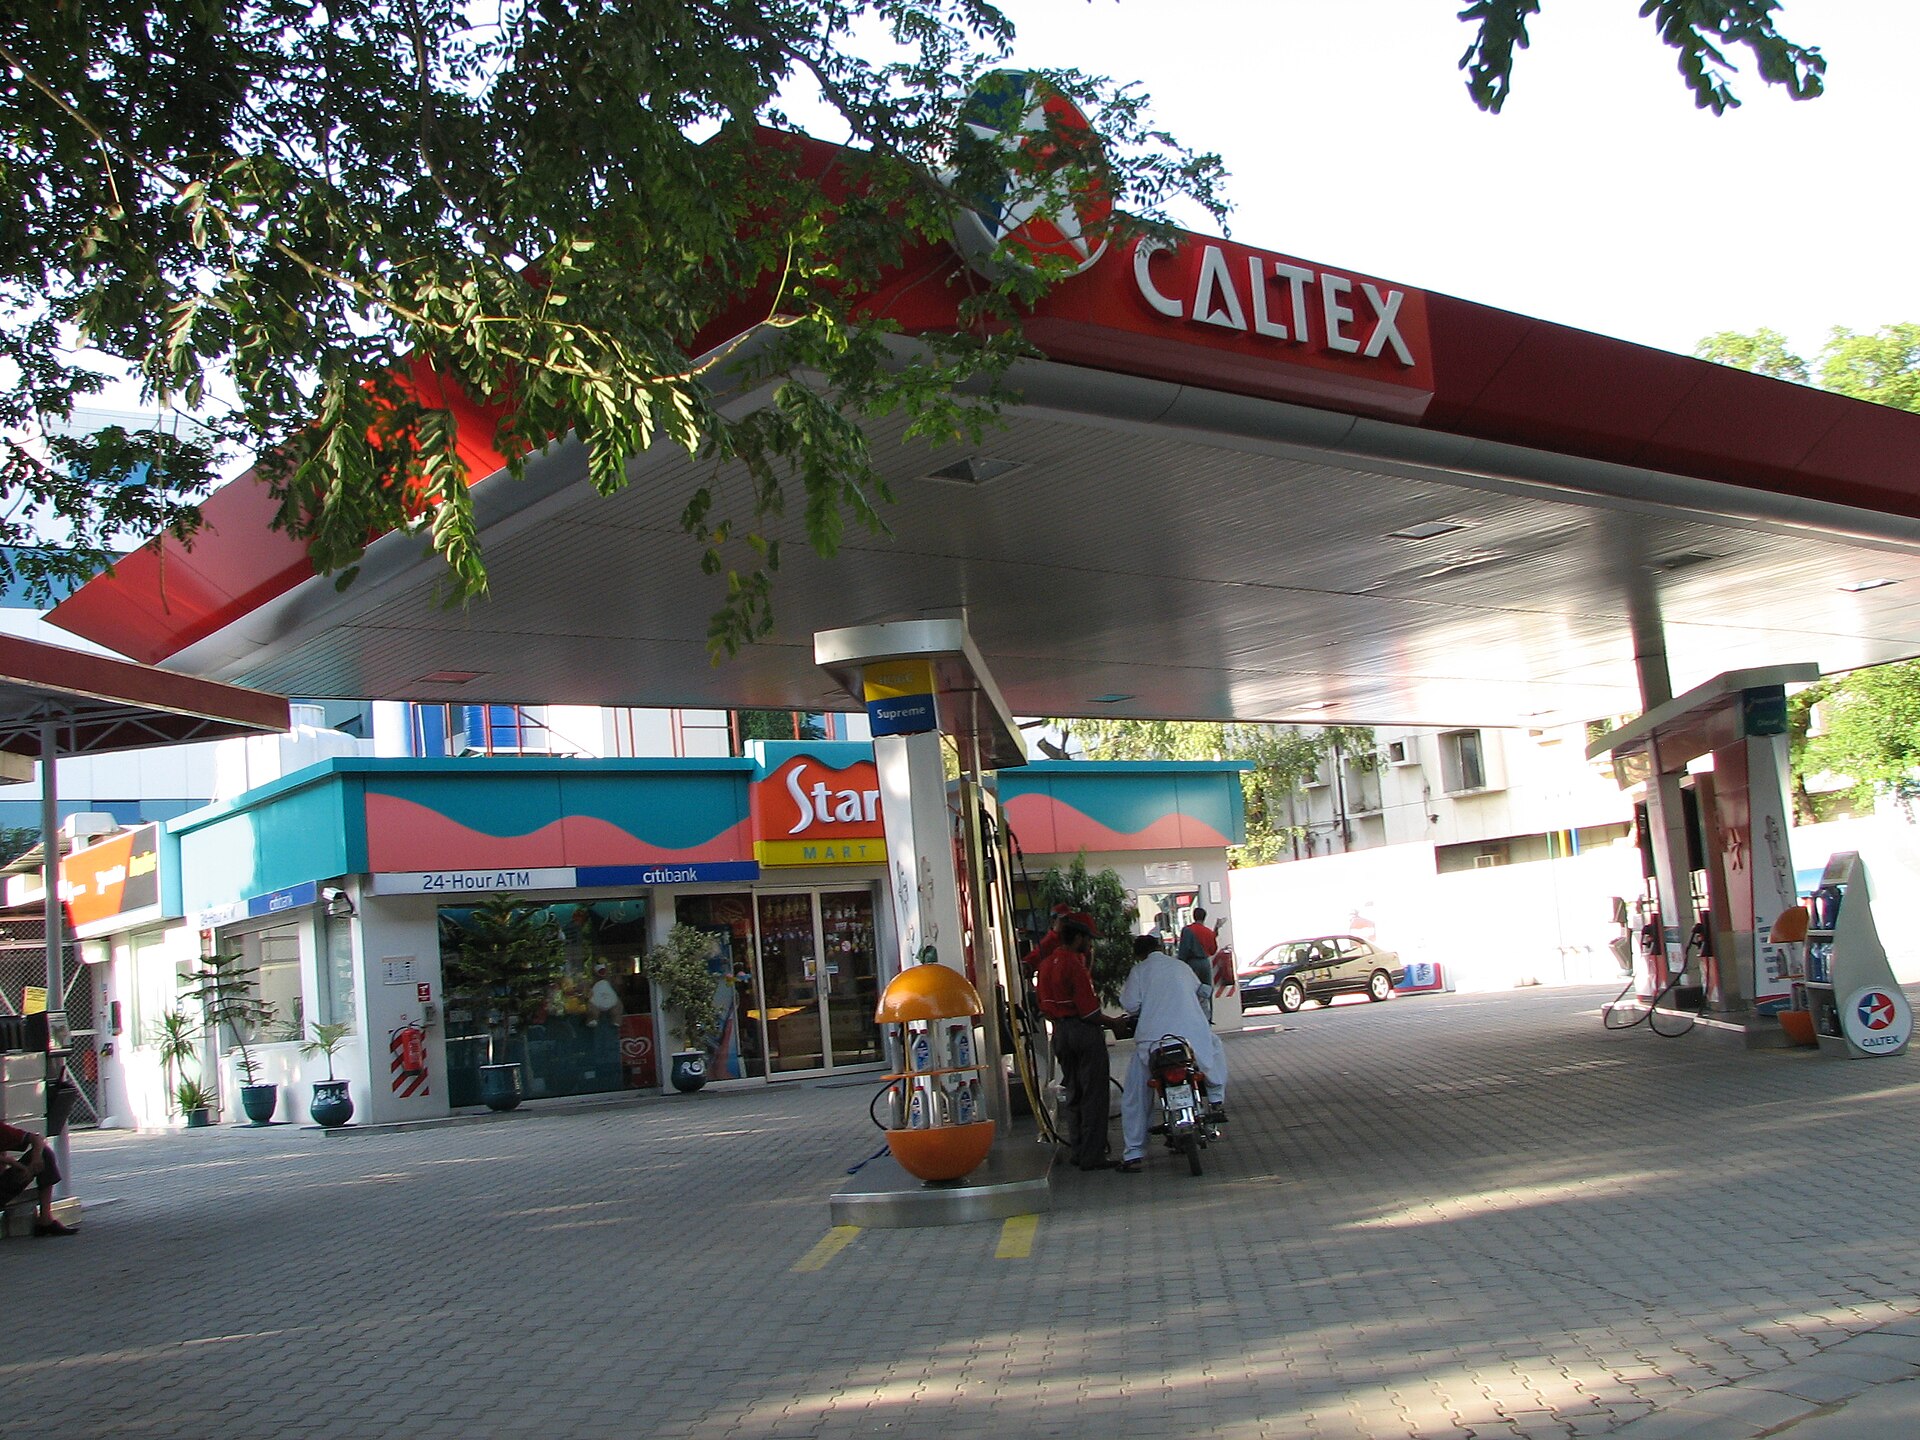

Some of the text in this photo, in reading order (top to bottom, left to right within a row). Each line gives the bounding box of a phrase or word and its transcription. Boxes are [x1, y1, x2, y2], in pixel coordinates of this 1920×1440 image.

[1134, 234, 1415, 366] CALTEX
[876, 706, 926, 721] Supreme
[786, 764, 880, 834] Star
[804, 845, 867, 859] MART
[422, 872, 530, 890] 24-Hour ATM
[642, 867, 697, 883] citibank
[1862, 1035, 1900, 1047] CALTEX
